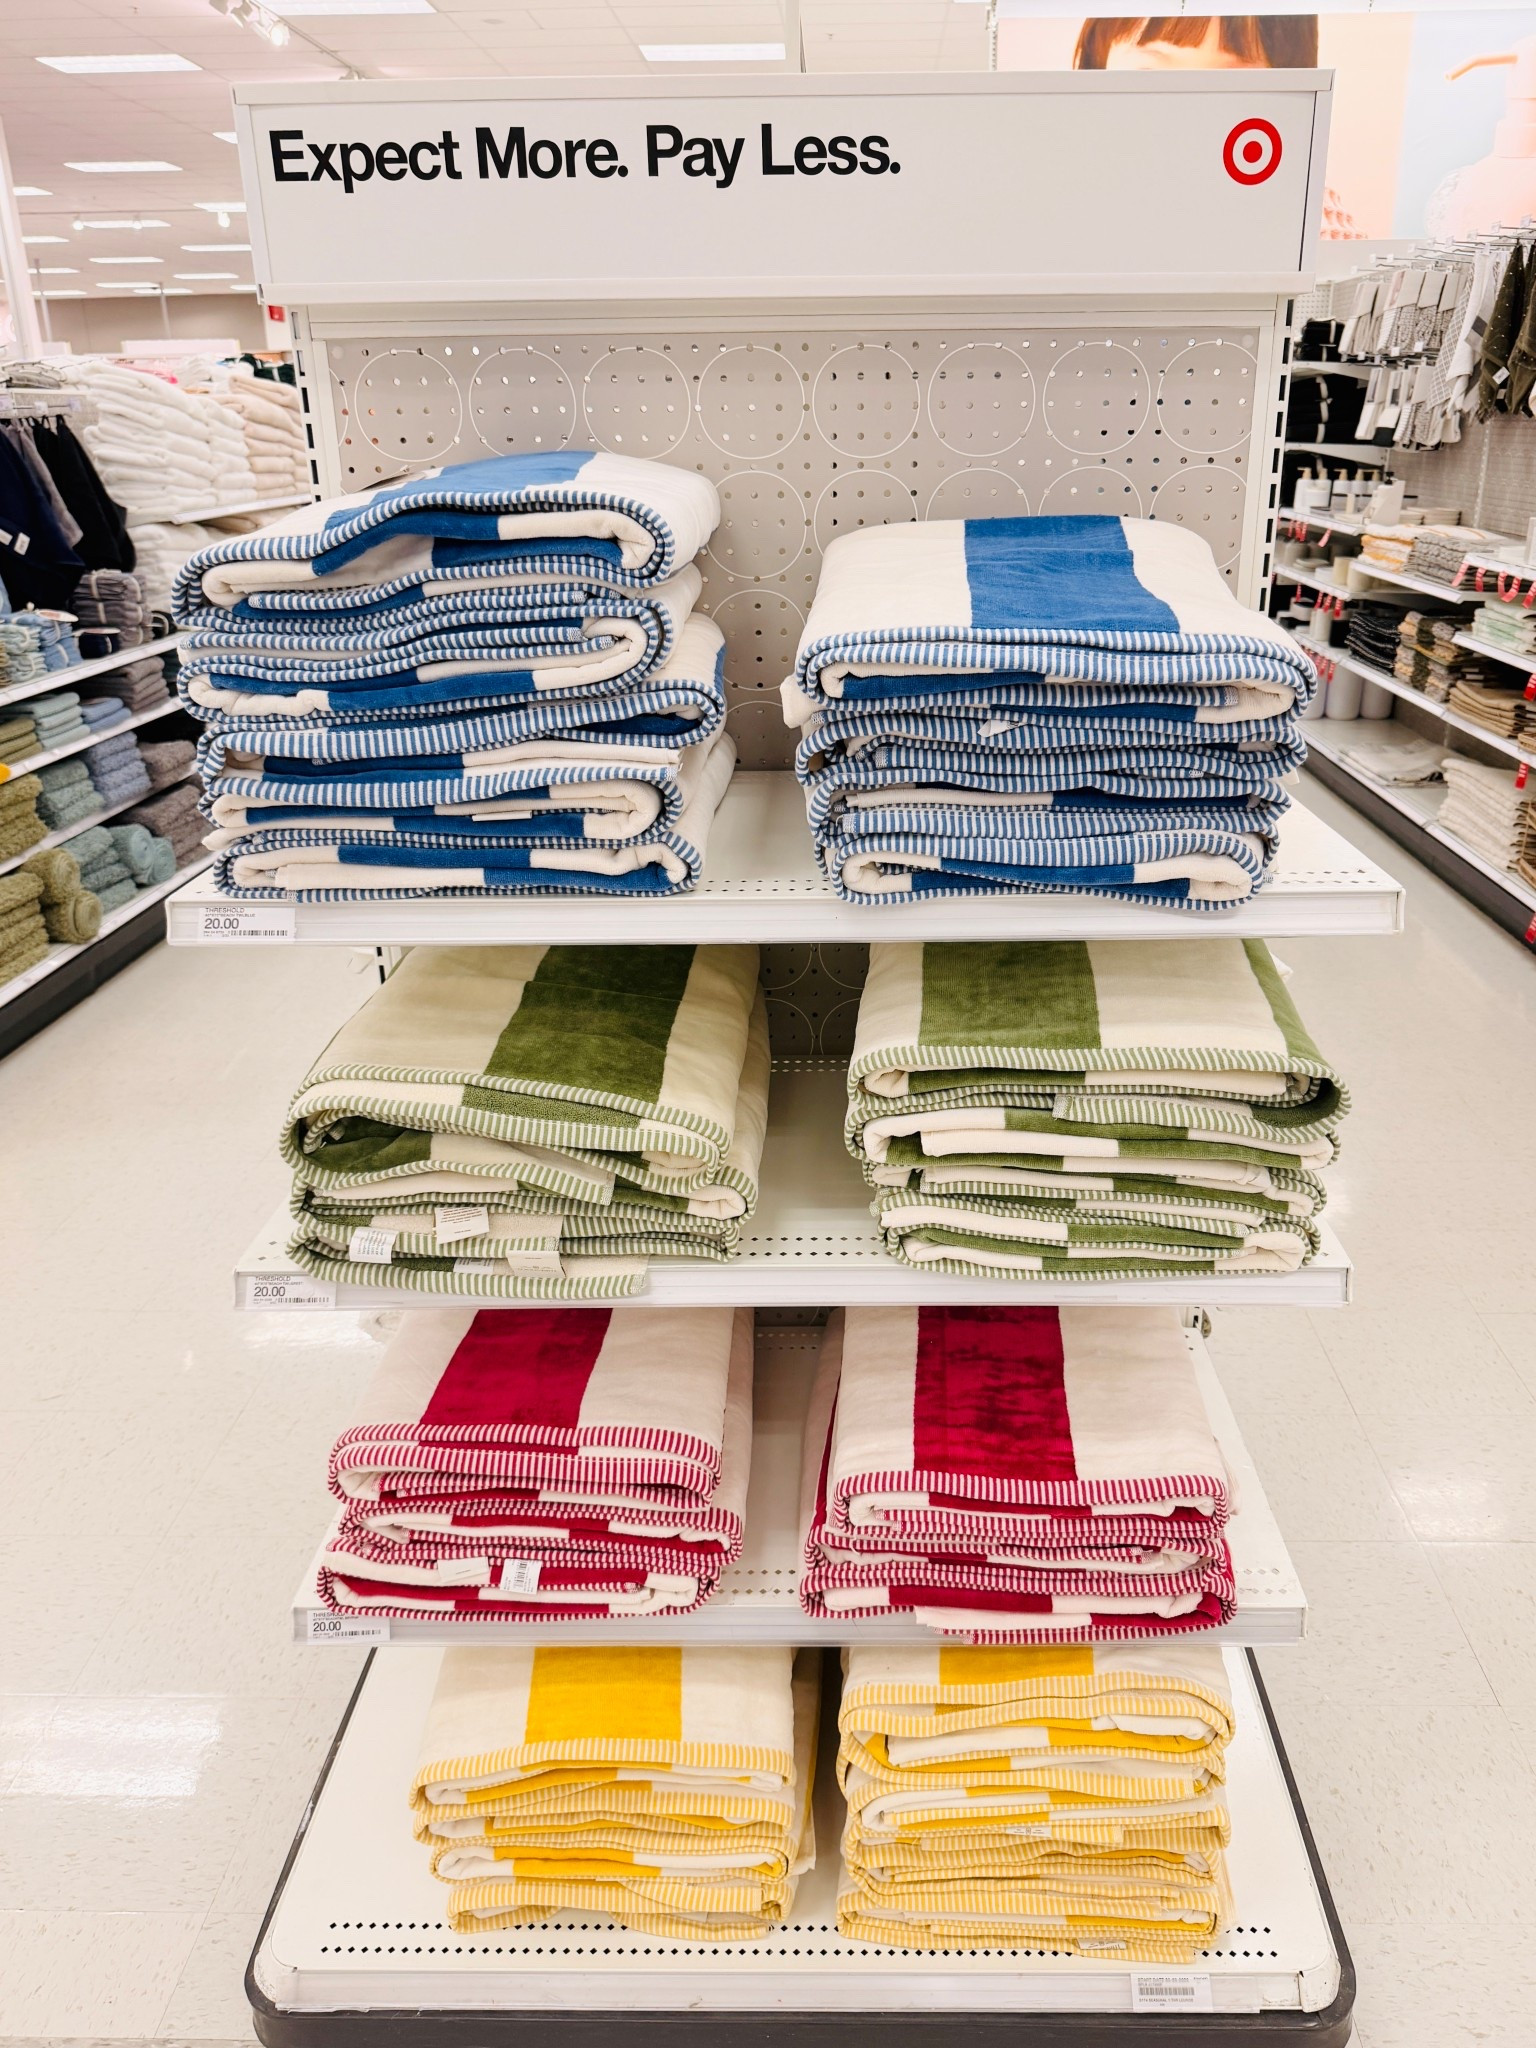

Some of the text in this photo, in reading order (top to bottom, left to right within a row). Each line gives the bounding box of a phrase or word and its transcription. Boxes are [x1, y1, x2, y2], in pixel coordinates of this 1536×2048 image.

[268, 123, 901, 194] Expect More. Pay Less.
[204, 918, 240, 930] 20.00
[253, 1286, 286, 1297] 20.00
[313, 1621, 342, 1633] 20.00
